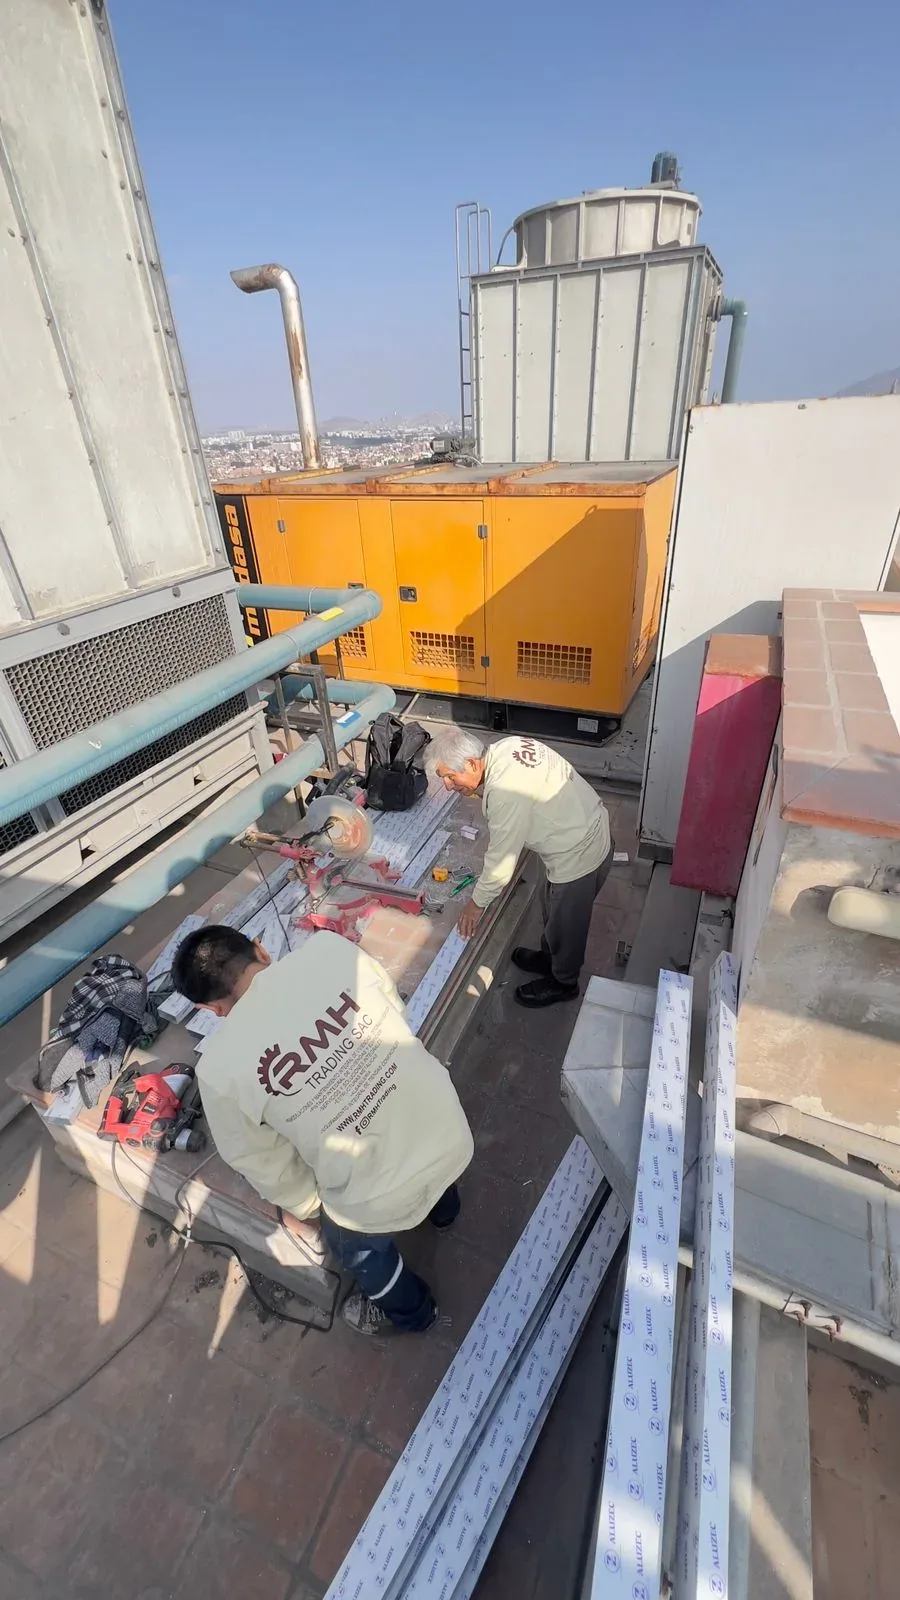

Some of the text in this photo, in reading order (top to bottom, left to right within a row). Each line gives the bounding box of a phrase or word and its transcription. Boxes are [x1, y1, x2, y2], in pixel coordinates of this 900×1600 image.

[224, 504, 261, 637] mdasa
[272, 991, 361, 1091] RMH
[304, 1013, 373, 1090] TRADING SAC
[336, 1063, 398, 1132] WWW.RMHTRADING.COM
[662, 1262, 670, 1289] ALUZEC
[710, 1294, 718, 1324] ALUZEC
[650, 1379, 658, 1413] ALUZEC
[718, 1368, 727, 1404] ALUZEC
[630, 1436, 638, 1475] ALUZEC
[608, 1500, 616, 1544] ALUZEC
[635, 1530, 644, 1576] ALUZEC
[709, 1522, 720, 1569] ALUZEC
[428, 1559, 438, 1584] ALUZEC
